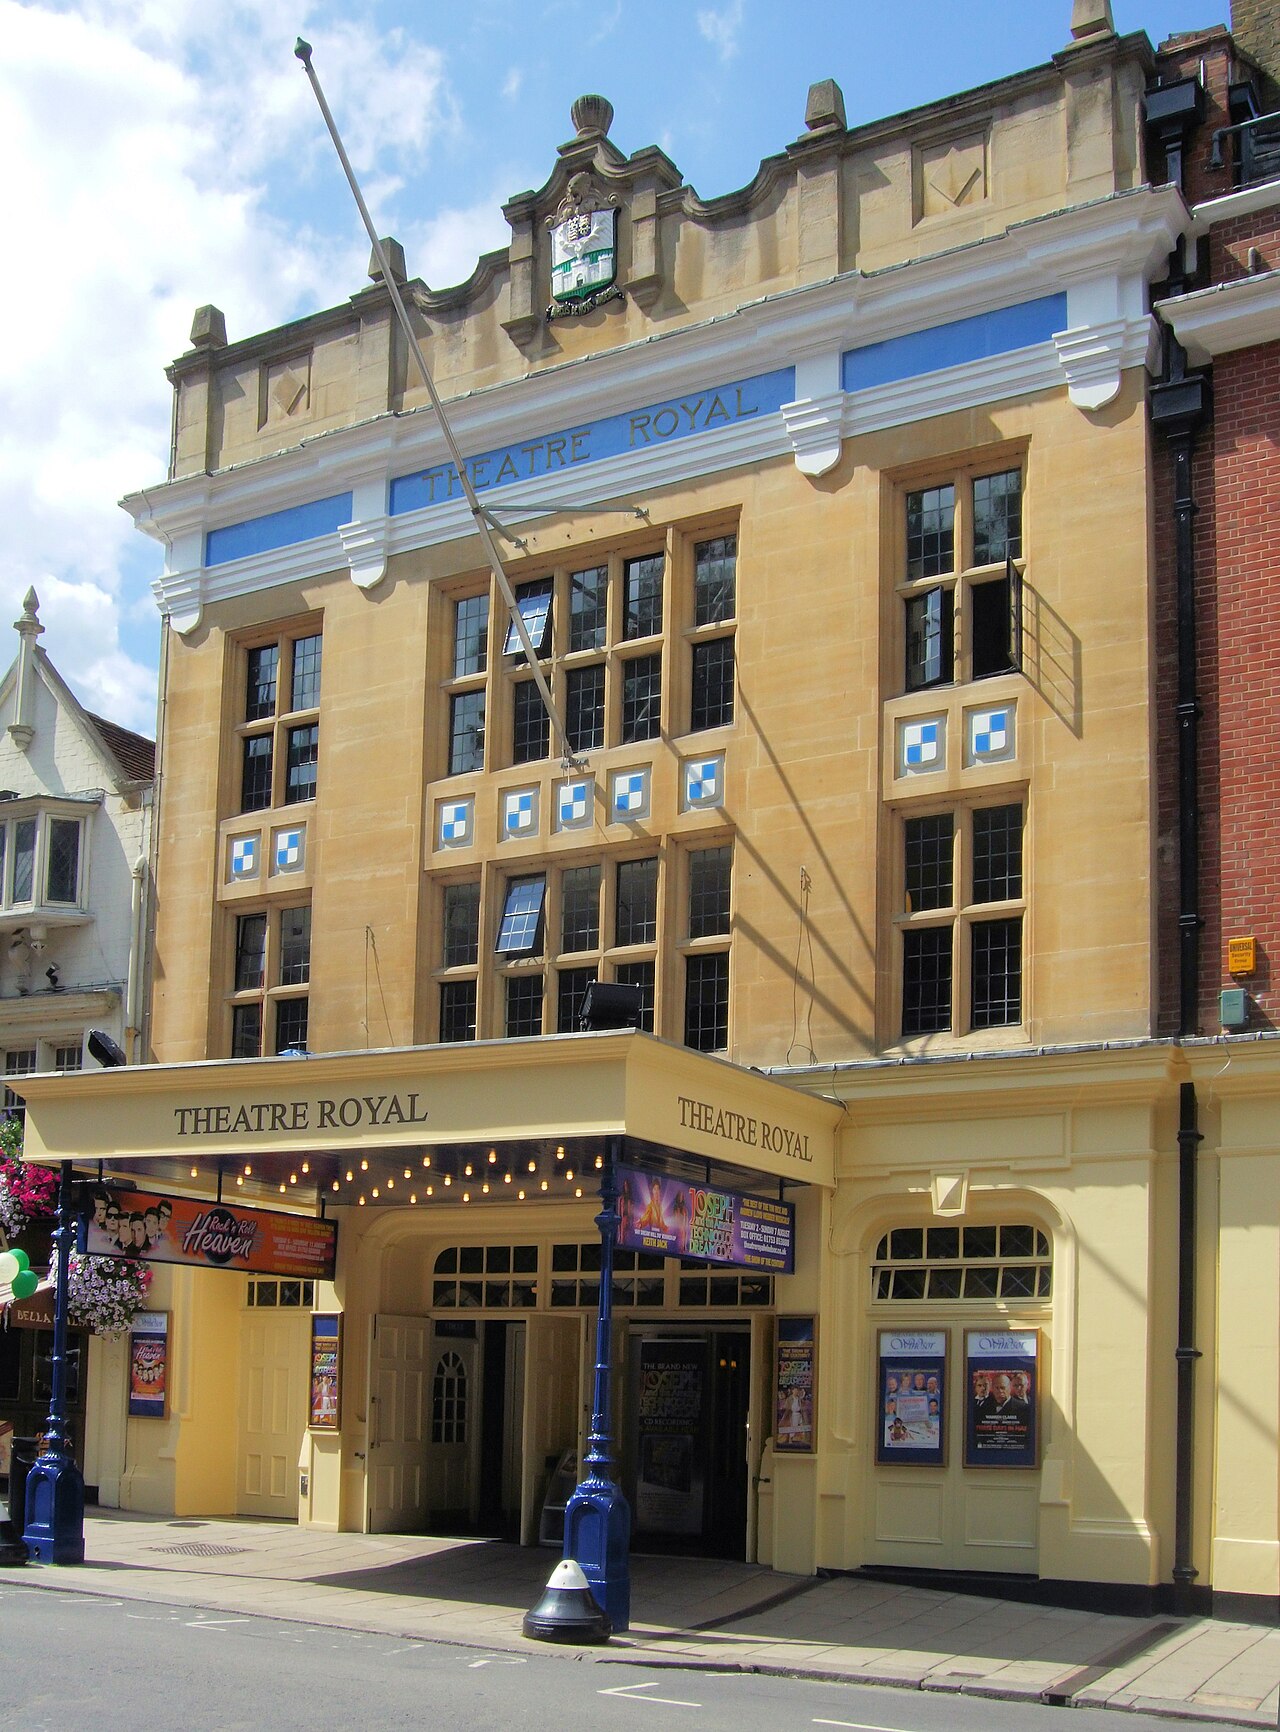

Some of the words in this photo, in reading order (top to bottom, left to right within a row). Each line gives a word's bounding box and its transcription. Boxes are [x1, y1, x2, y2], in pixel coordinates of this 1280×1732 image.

[421, 430, 591, 501] THEATRE
[629, 386, 758, 447] ROYAL
[174, 1102, 309, 1135] THEATRE
[316, 1093, 428, 1128] ROYAL
[678, 1096, 757, 1146] THEATRE
[761, 1122, 813, 1162] ROYAL
[688, 1187, 736, 1225] JOSEPH
[210, 1216, 231, 1231] Rock
[239, 1220, 257, 1234] Roll
[740, 1221, 756, 1230] TUESDAY
[777, 1228, 790, 1237] AUGUST
[183, 1213, 253, 1258] Heaven
[741, 1230, 749, 1239] BOX
[17, 1310, 52, 1323] BELLA
[890, 1337, 936, 1350] Windsor
[978, 1337, 1026, 1350] Windsor
[779, 1361, 812, 1374] JOSEPH
[640, 1370, 703, 1394] JOSEPH
